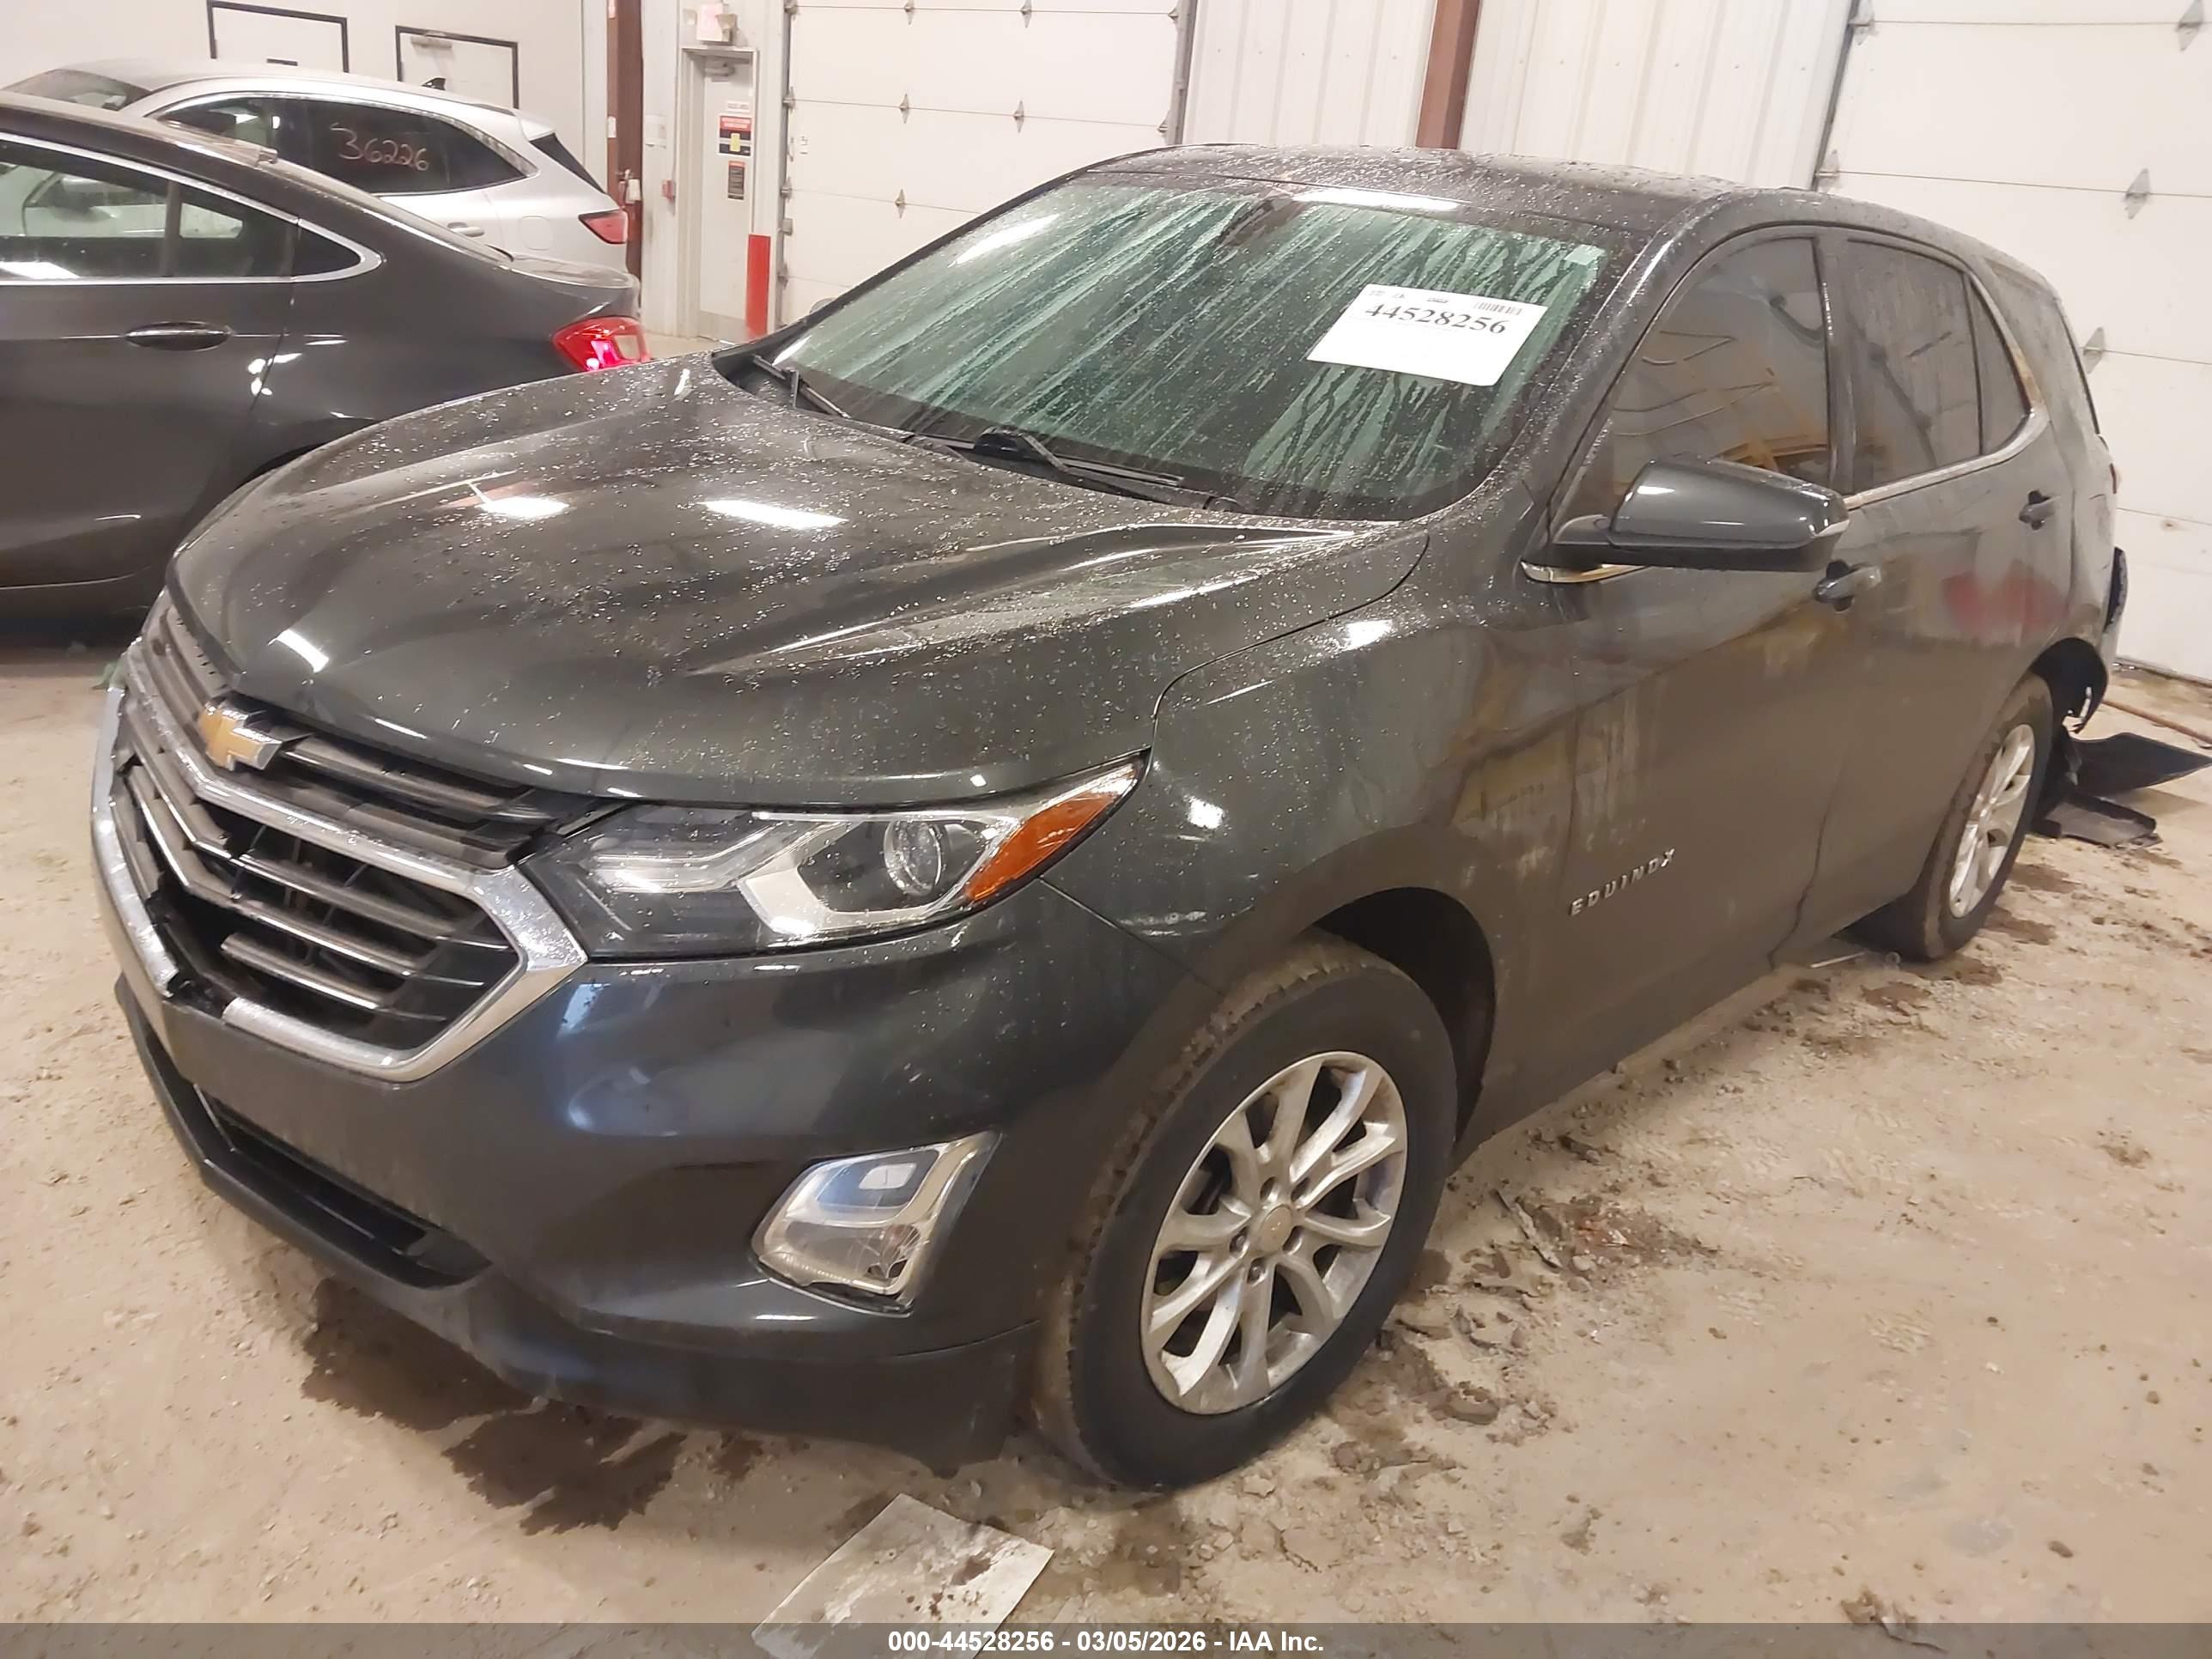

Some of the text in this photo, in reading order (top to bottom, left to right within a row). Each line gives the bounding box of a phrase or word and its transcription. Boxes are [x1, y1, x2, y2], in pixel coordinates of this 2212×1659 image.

[330, 122, 428, 171] 36226
[1365, 303, 1510, 334] 44528256
[1571, 848, 1675, 916] EQUINOX
